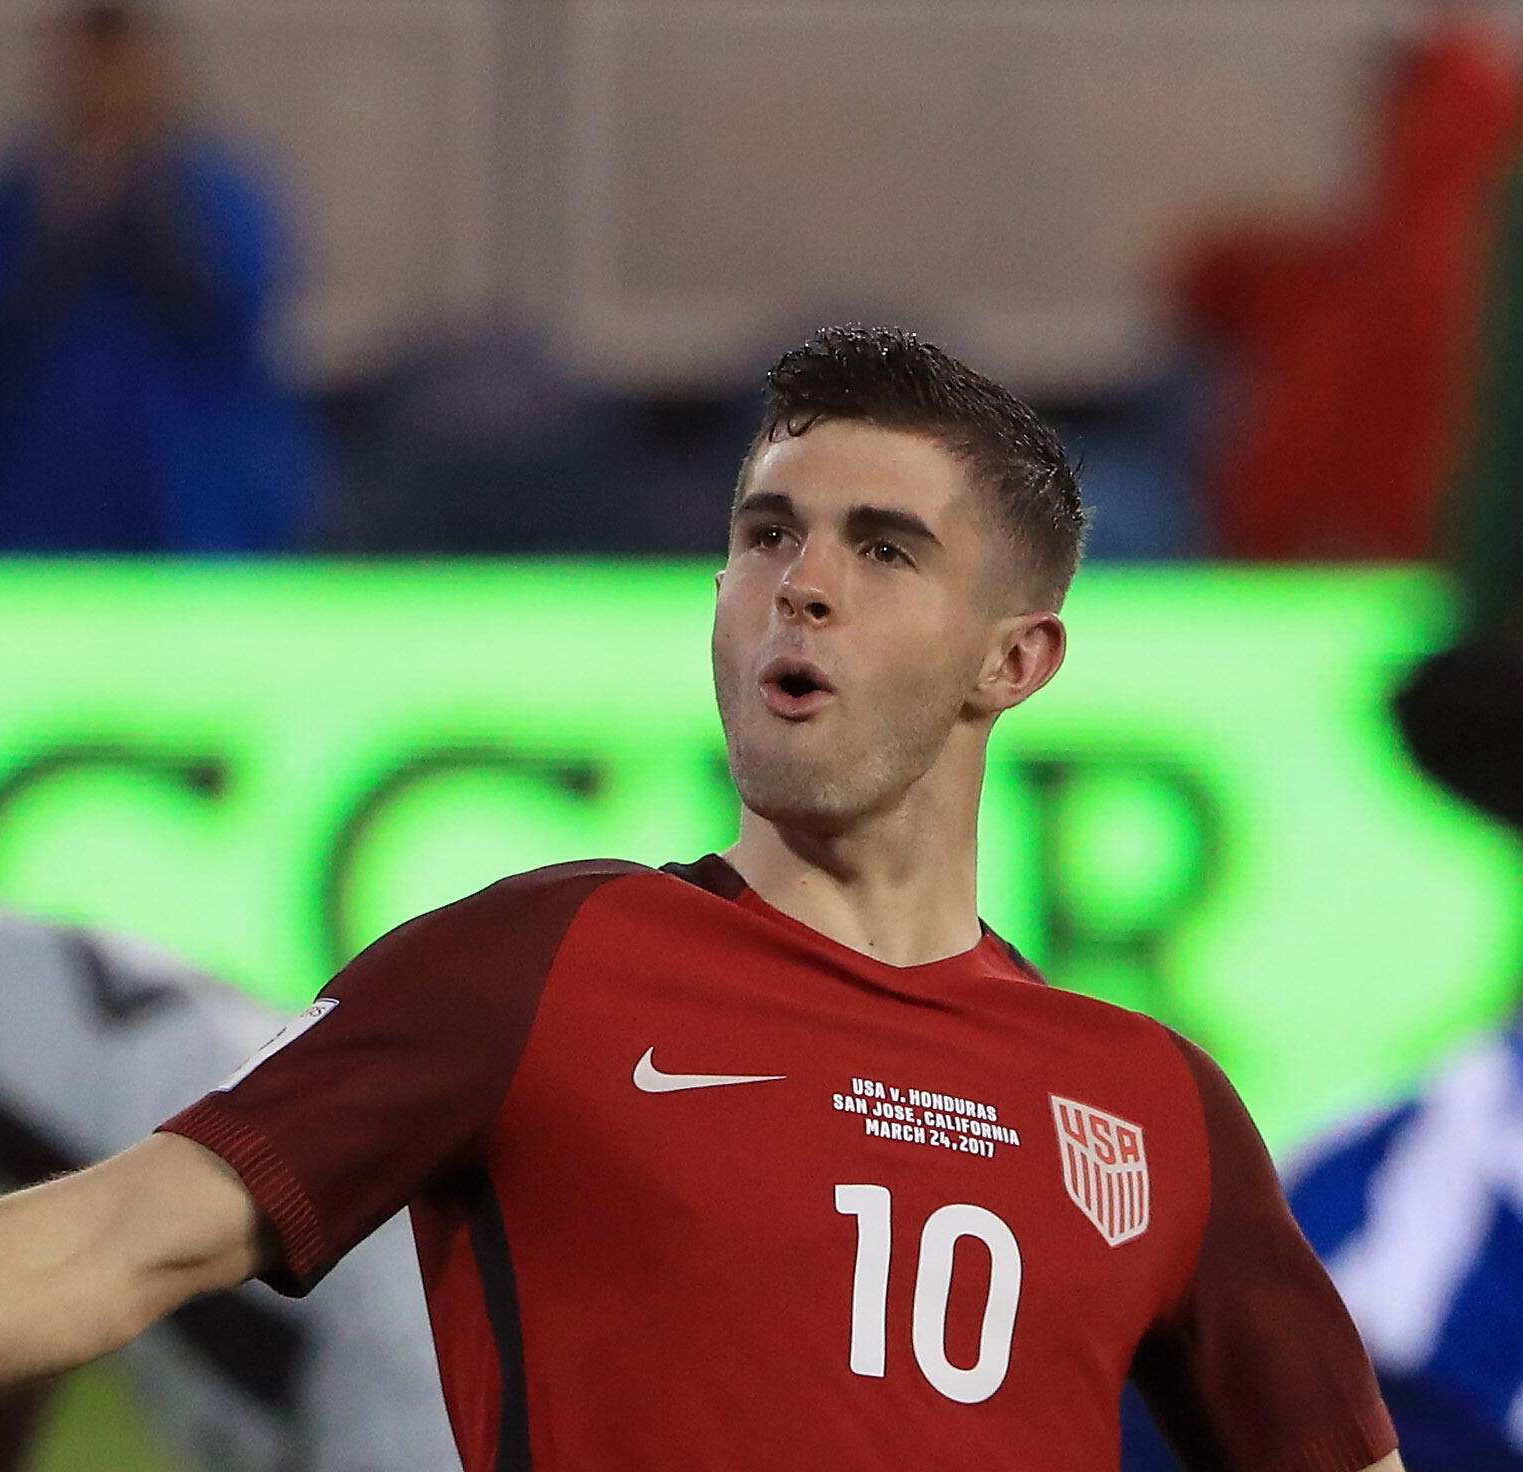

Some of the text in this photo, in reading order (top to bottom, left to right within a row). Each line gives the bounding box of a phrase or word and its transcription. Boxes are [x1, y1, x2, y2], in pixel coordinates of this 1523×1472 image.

[832, 1093, 1020, 1146] SAN JOSE, CALIFORNIA
[851, 1077, 886, 1099] USA
[908, 1088, 998, 1122] HONDURAS
[865, 1118, 926, 1144] MARCH
[1059, 1104, 1140, 1165] USA
[834, 1183, 1022, 1404] 10
